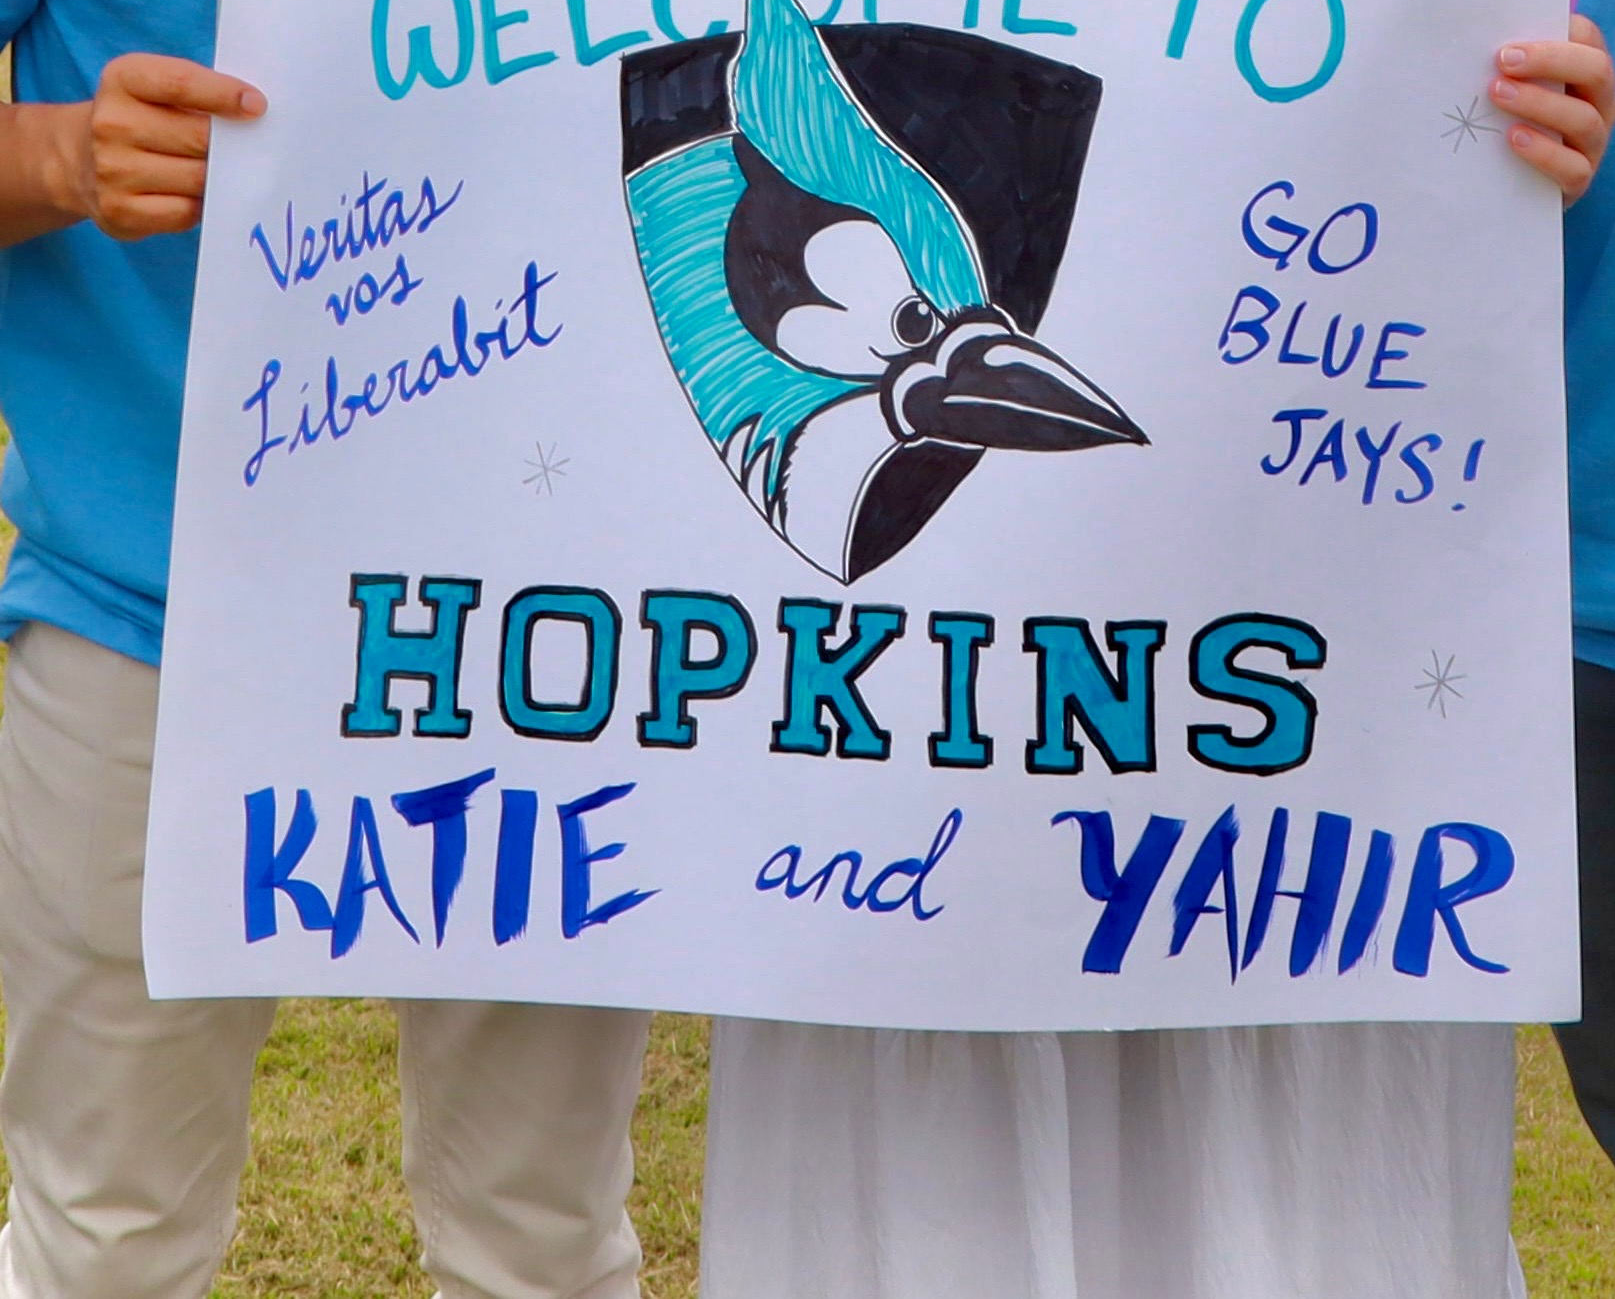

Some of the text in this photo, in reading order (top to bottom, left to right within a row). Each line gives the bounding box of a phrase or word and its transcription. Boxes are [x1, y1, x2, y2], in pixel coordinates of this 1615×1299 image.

[248, 169, 464, 293] Veritas
[1241, 179, 1380, 275] GO
[325, 253, 425, 326] vos
[1217, 284, 1428, 390] BLUE
[241, 259, 564, 488] Liberabit
[1259, 407, 1486, 513] JAYS!
[339, 572, 1329, 778] HOPKINS
[242, 766, 1518, 985] KATIE and YAHIR
